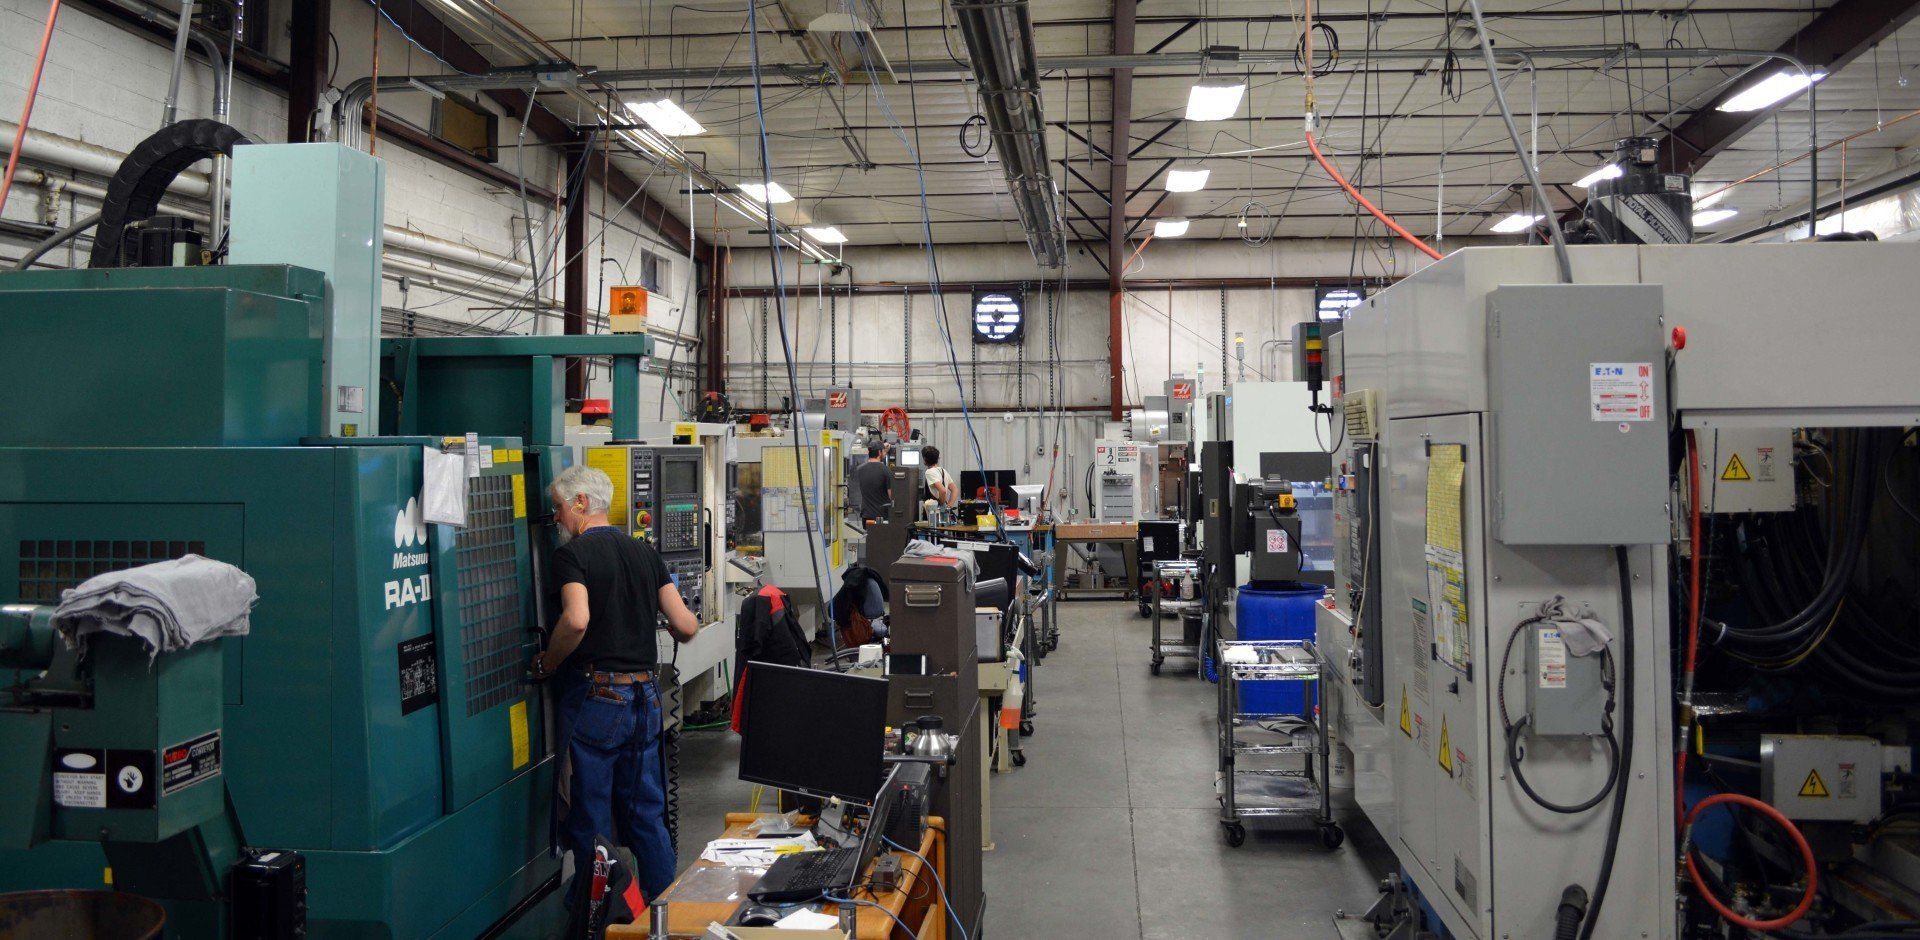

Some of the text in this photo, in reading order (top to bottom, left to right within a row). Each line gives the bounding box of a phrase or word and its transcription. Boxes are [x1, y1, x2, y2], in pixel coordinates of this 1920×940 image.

[1638, 366, 1649, 377] ON
[1640, 405, 1650, 418] OFF
[393, 552, 429, 569] Matsuur
